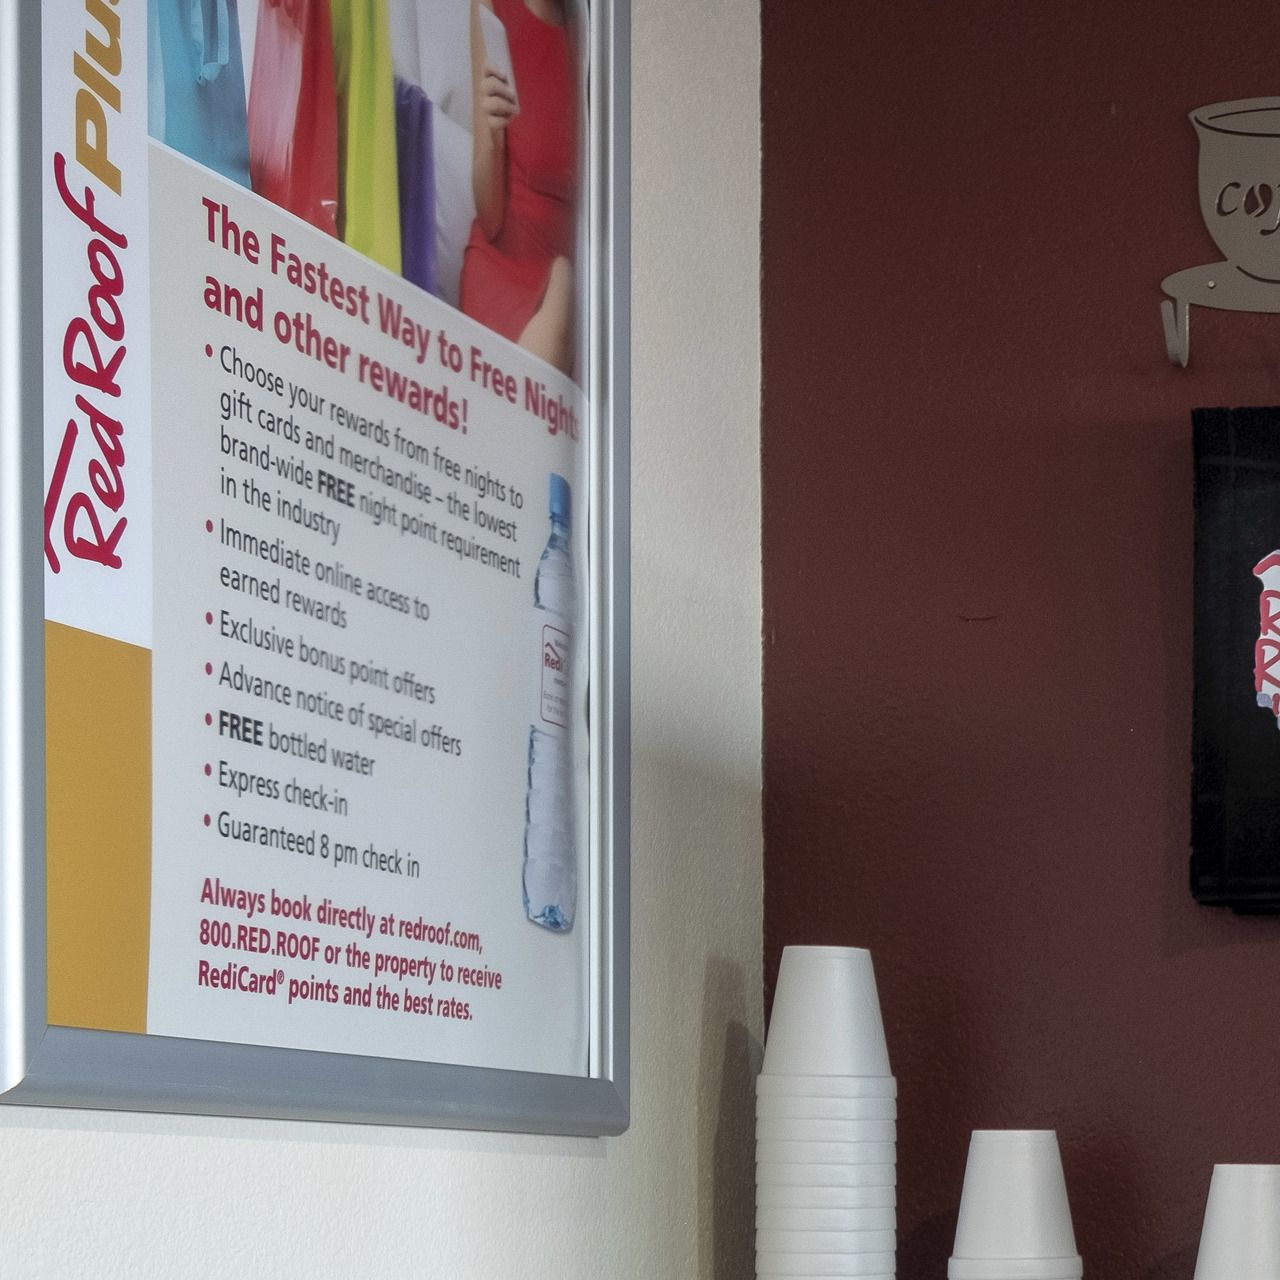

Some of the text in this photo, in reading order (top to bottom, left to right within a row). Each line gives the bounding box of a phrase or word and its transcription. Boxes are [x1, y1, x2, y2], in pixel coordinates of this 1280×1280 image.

[74, 0, 122, 197] Plu
[202, 196, 260, 265] The
[271, 232, 370, 325] Fastest
[378, 292, 431, 364] Way
[438, 330, 463, 373] to
[470, 345, 517, 404] Free
[204, 275, 467, 435] and other rewards!
[220, 345, 523, 509] Choose your rewards from free nights to
[220, 389, 517, 542] gift cards and merchandise the lowest
[221, 425, 521, 579] brand-wide FREE night point requirement
[221, 466, 341, 546] in the industry
[220, 566, 347, 629] earned rewards
[221, 518, 430, 621] Immediate online access to
[221, 610, 435, 704] Exclusive bonus point offers
[219, 661, 461, 756] Advance notice of special offers
[219, 710, 376, 777] FREE bottled water
[219, 760, 348, 816] Express check-in
[218, 810, 420, 879] Guaranteed 8 pm check in
[200, 878, 483, 954] Always book directly at redroof.com,
[200, 918, 502, 990] 800.RED.ROOF or the property to receive
[288, 974, 339, 1004] points
[343, 982, 372, 1007] and
[376, 984, 399, 1012] the
[404, 987, 433, 1016] best
[437, 997, 473, 1021] rates.
